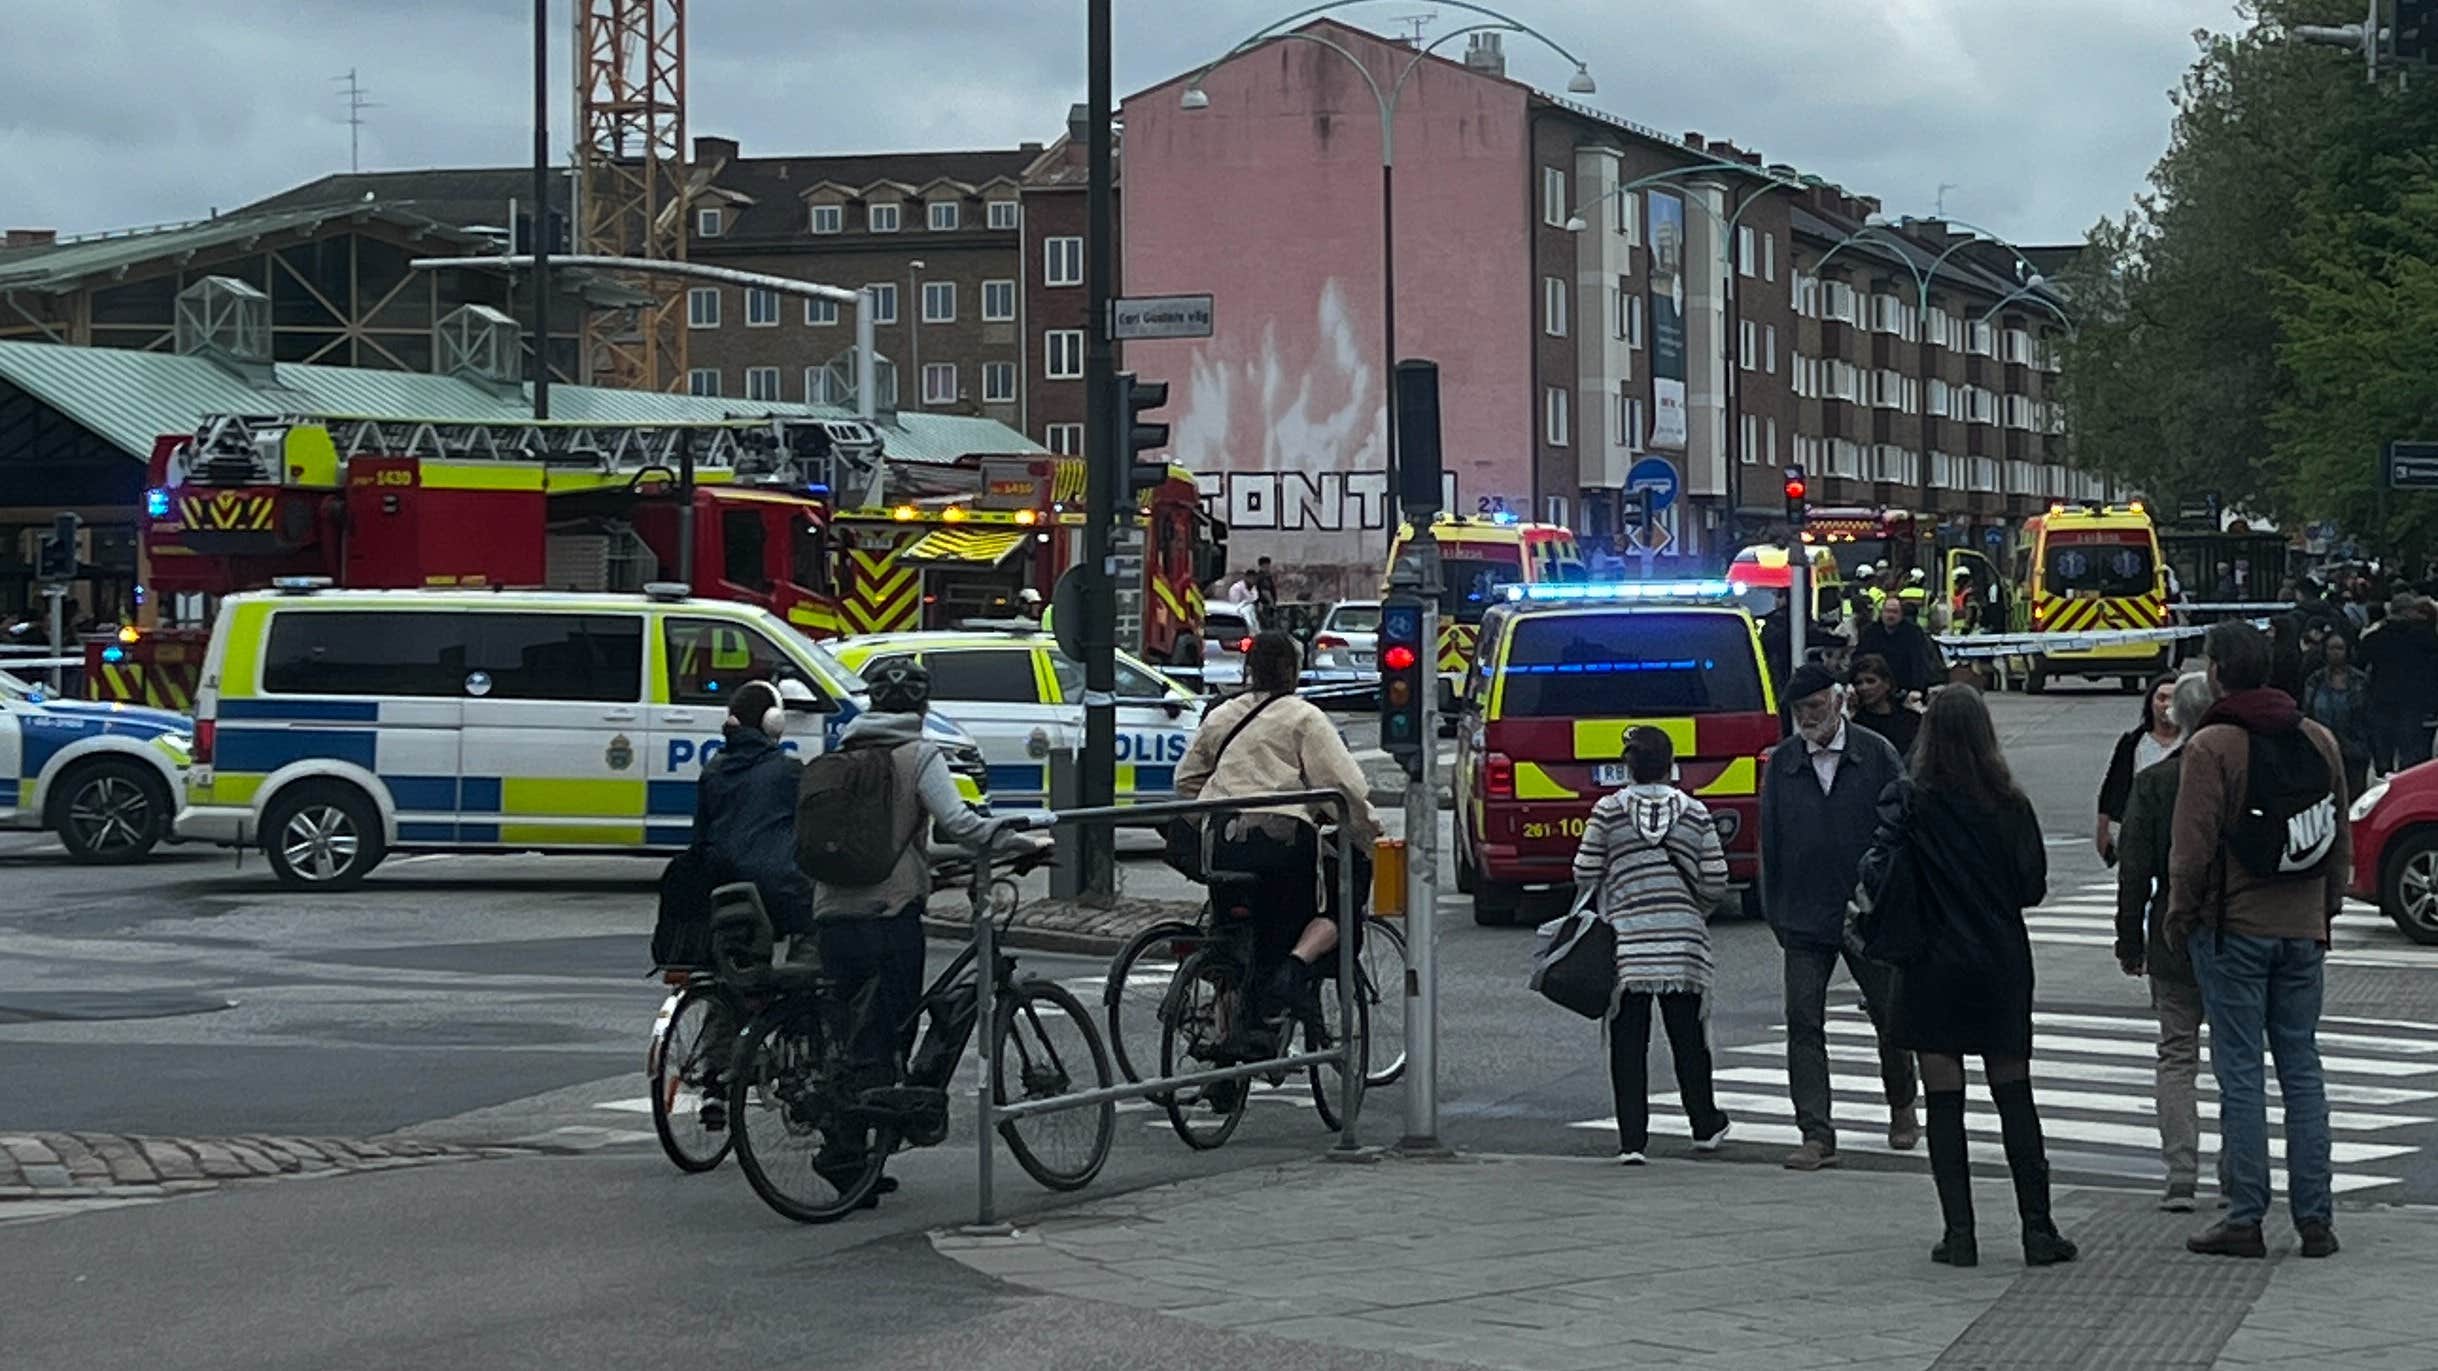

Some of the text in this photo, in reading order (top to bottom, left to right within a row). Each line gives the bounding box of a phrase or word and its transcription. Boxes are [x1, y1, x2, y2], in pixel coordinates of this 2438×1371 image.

[1118, 312, 1140, 325] Carl
[1188, 308, 1209, 325] väg
[1478, 495, 1504, 513] 23
[1115, 733, 1187, 762] OLIS
